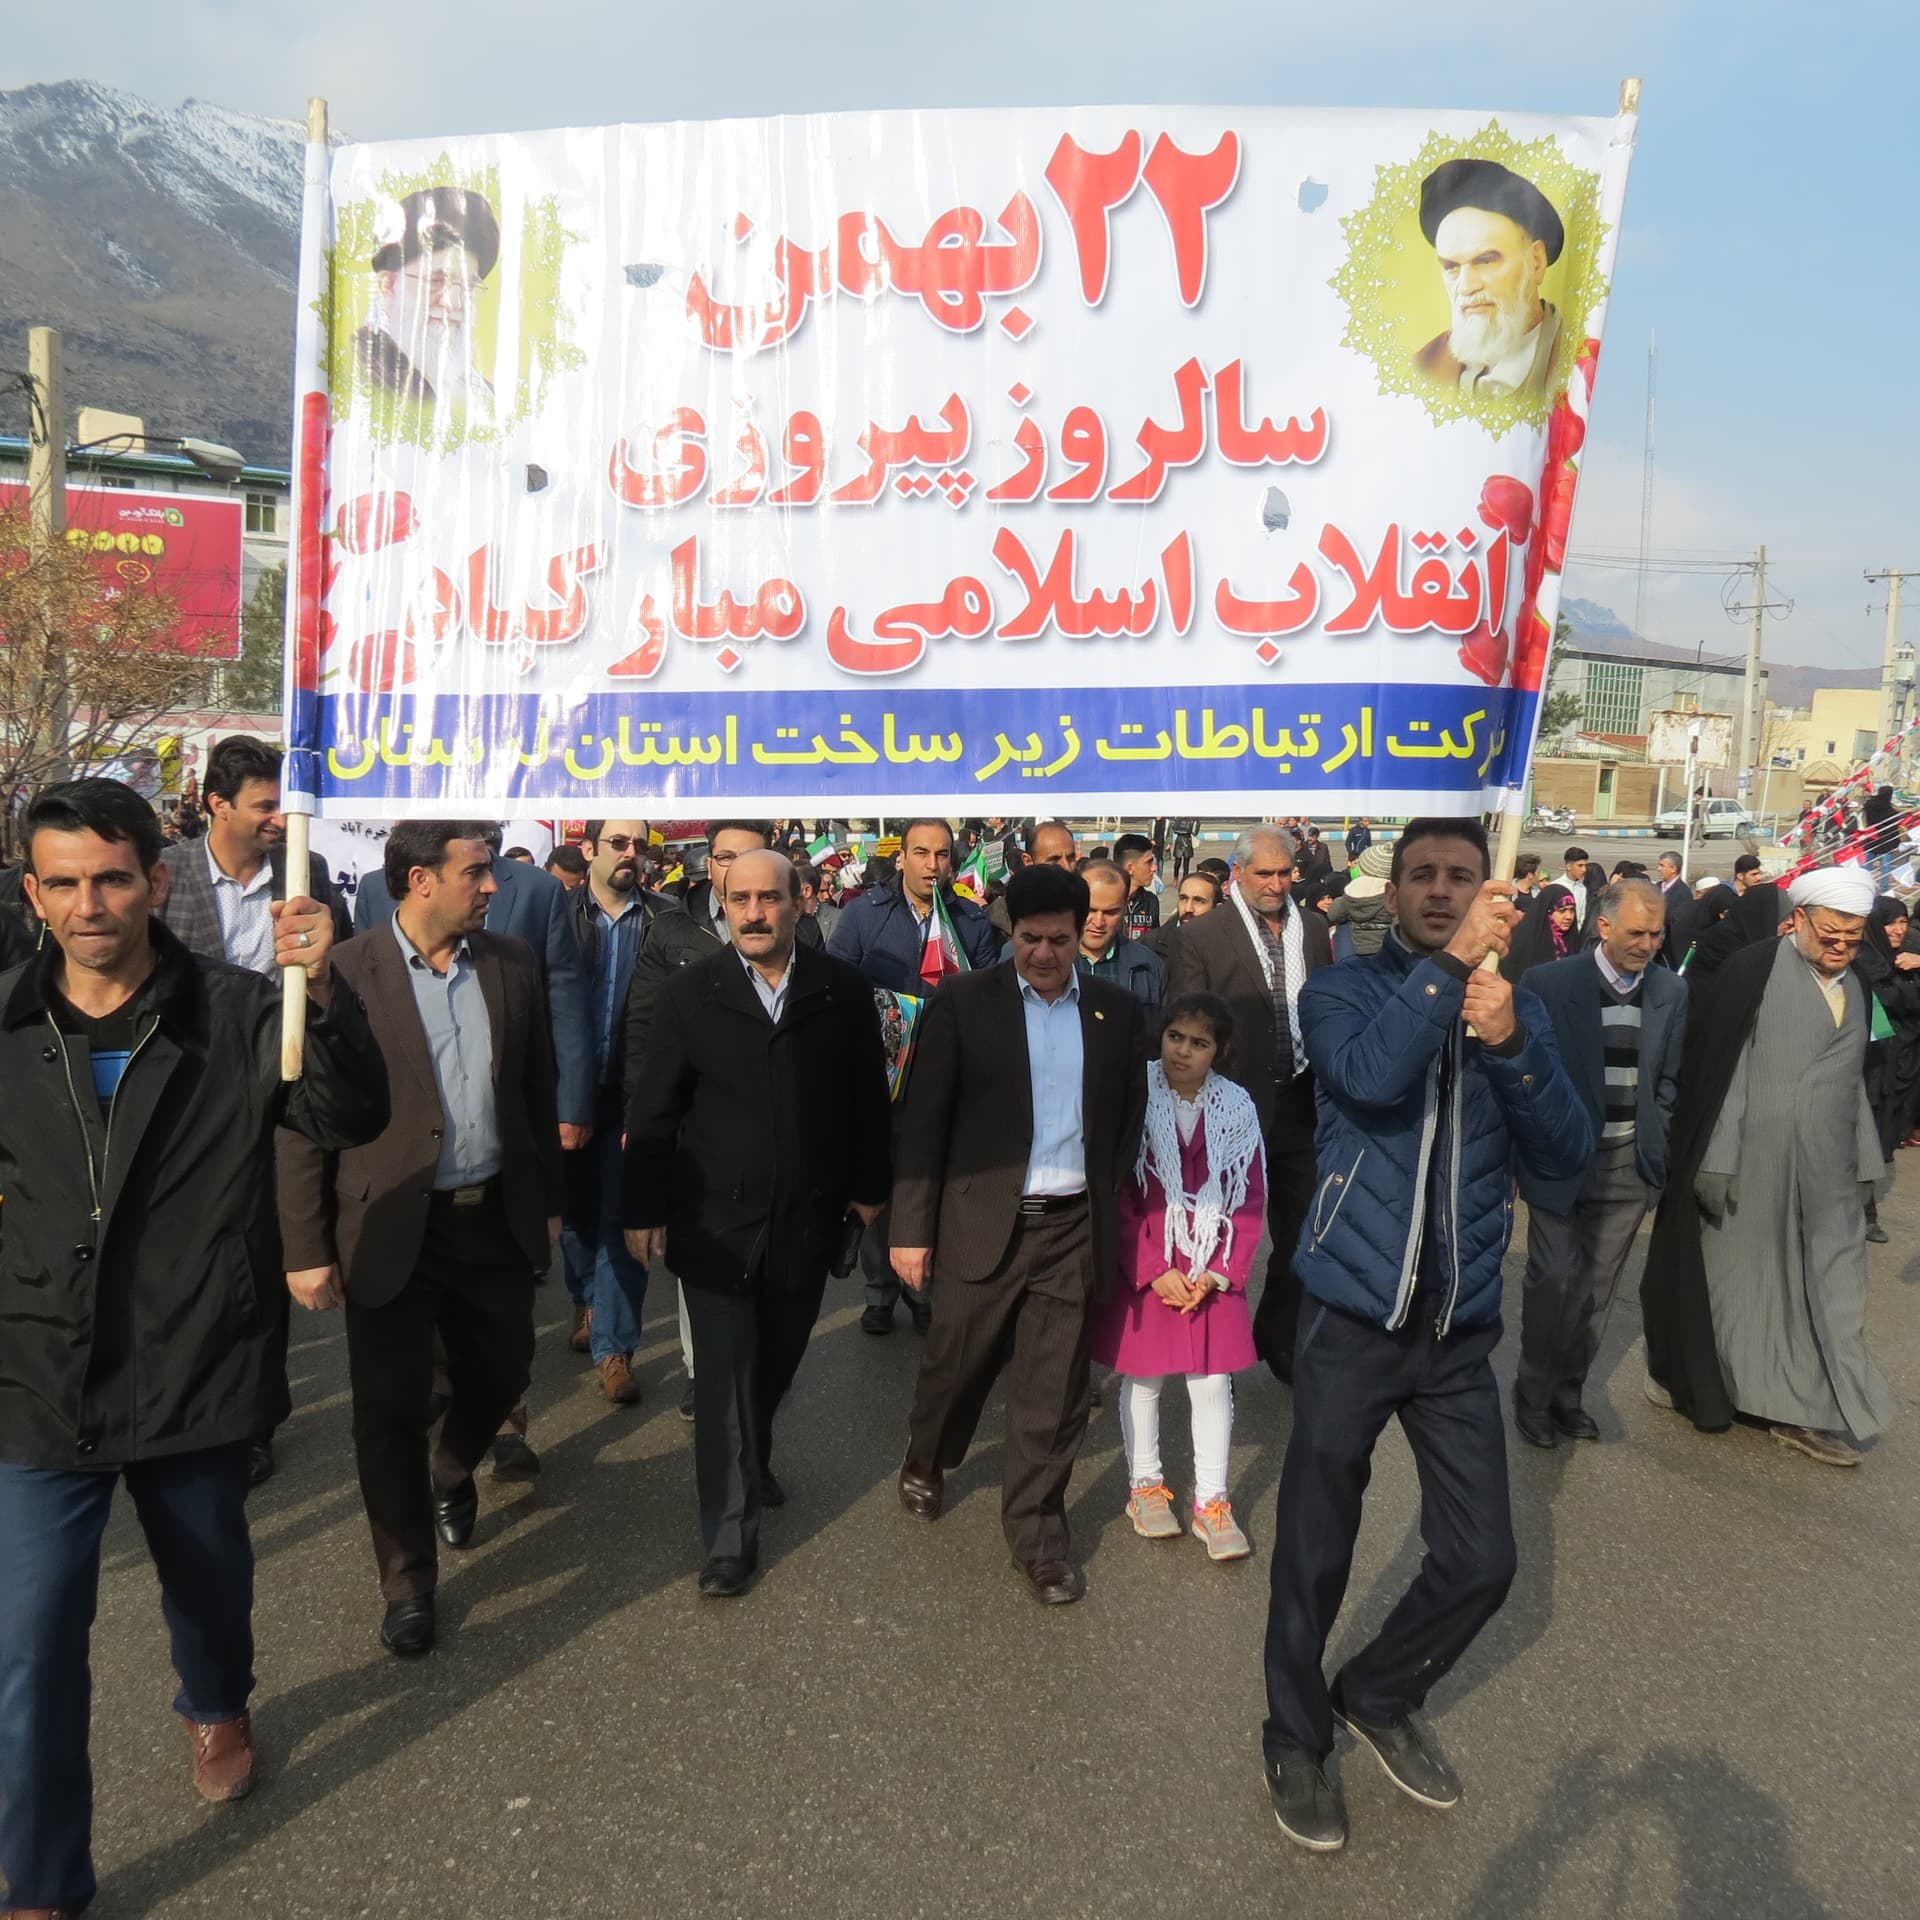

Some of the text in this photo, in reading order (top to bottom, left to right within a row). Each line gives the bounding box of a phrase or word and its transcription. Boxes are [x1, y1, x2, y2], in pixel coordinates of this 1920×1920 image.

[686, 129, 1240, 350] ۲۲ بهمن
[610, 356, 1328, 507] سالروز پیروزی
[827, 527, 1193, 674] اسلامی
[1215, 522, 1509, 664] انقلاب
[327, 716, 549, 780] لستان
[564, 715, 738, 780] استان
[752, 713, 963, 765] ساخت
[975, 716, 1081, 781] زیر
[1096, 707, 1373, 775] ارتباطات
